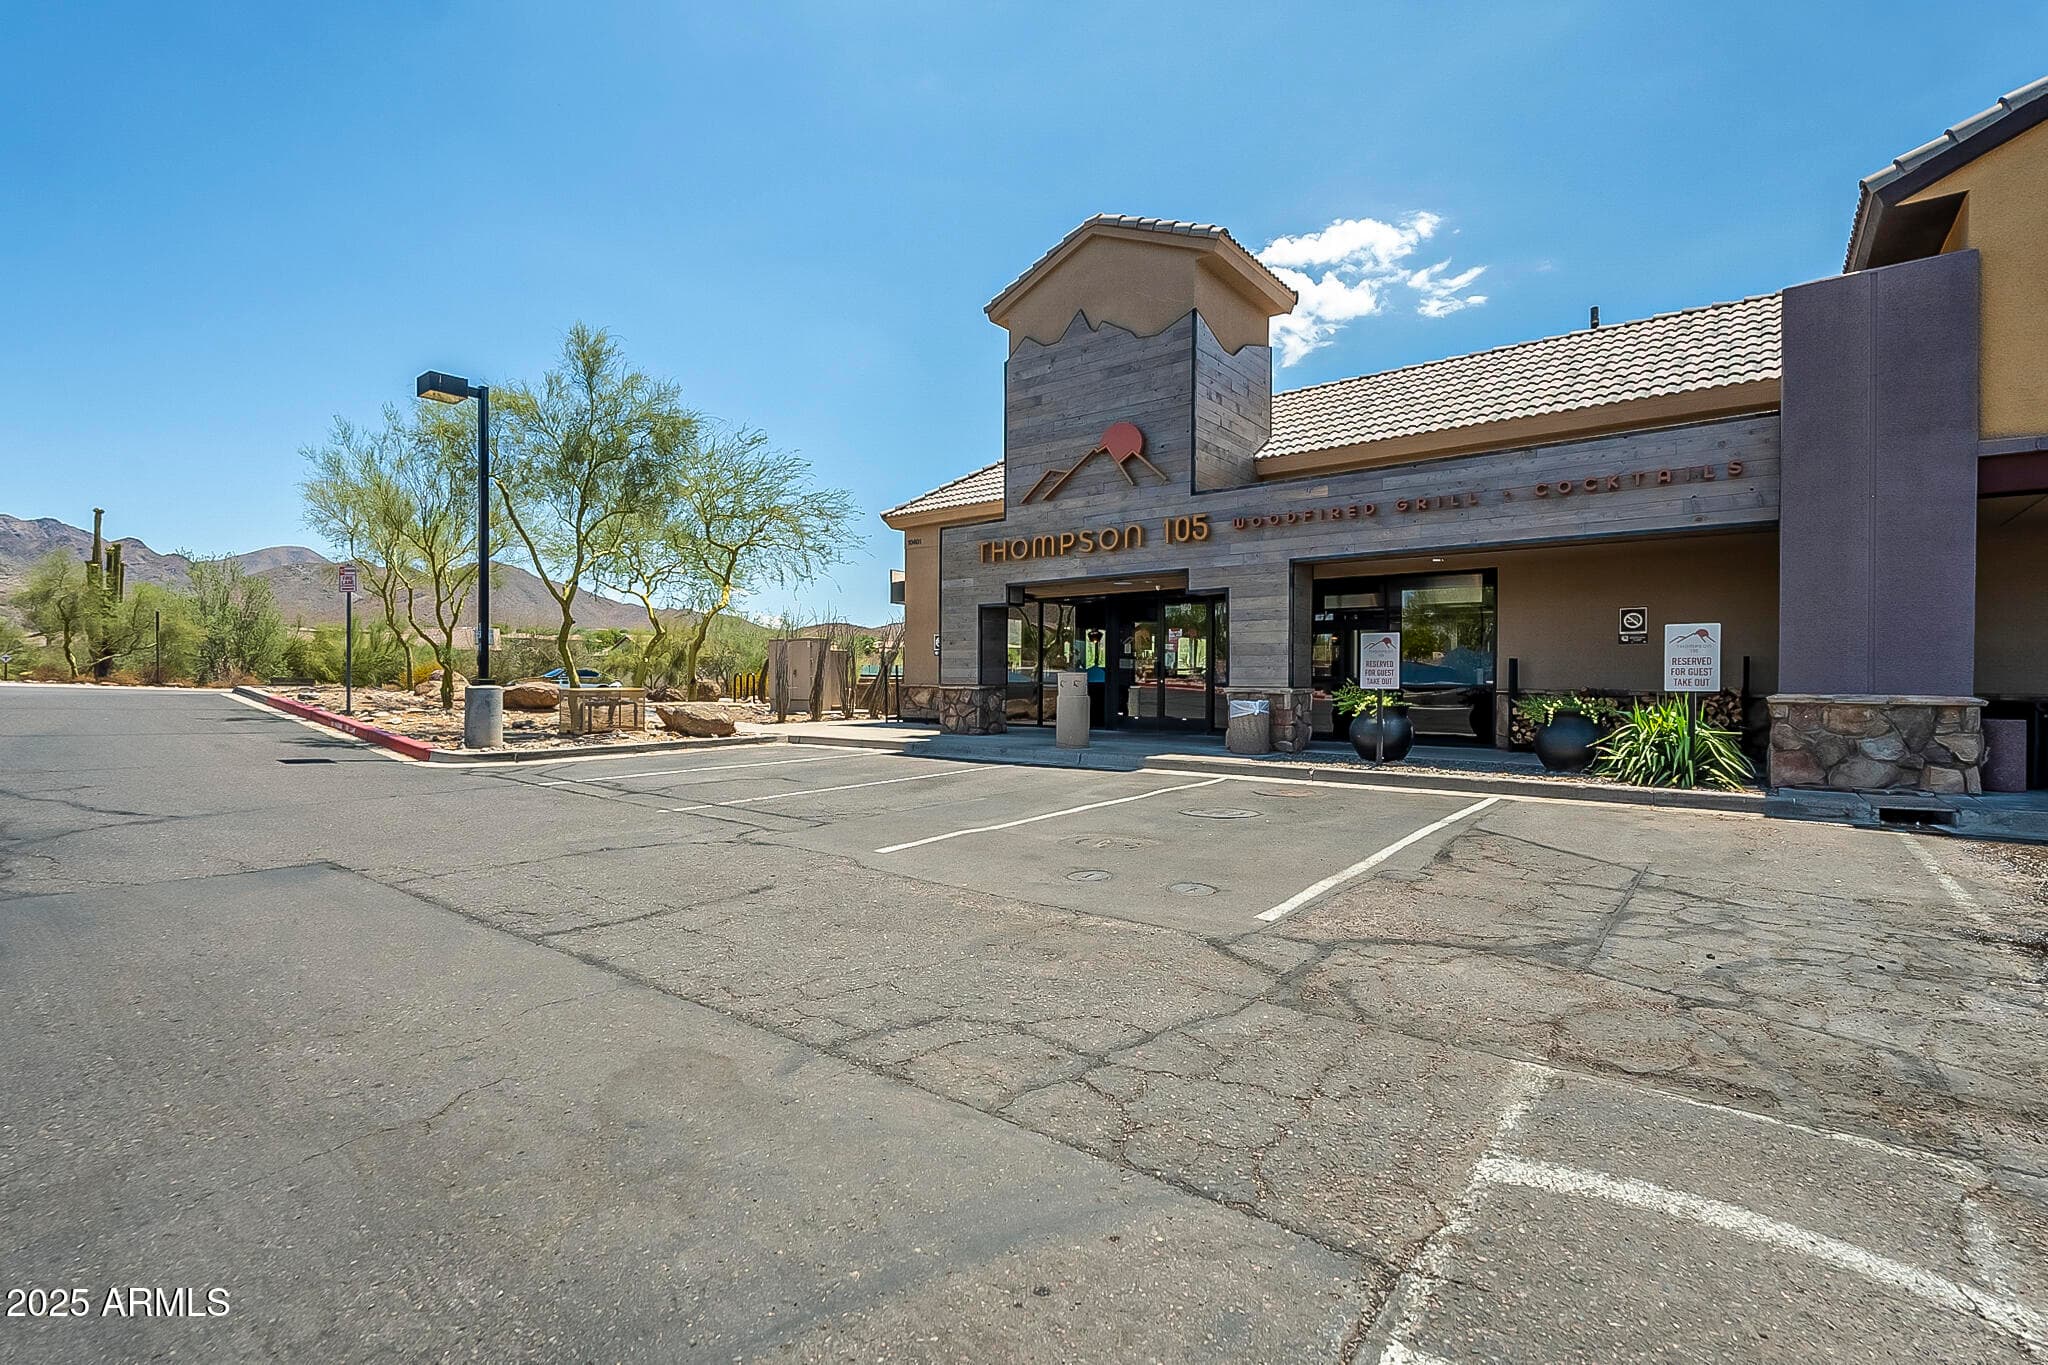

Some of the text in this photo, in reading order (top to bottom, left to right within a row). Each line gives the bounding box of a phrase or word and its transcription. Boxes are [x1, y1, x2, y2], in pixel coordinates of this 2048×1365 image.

[1232, 502, 1376, 529] WOODFIRED
[1395, 492, 1479, 512] GRILL
[1534, 458, 1744, 497] COCKTAILS
[977, 512, 1210, 563] THOMPSON 105
[1671, 657, 1712, 666] RESERVED
[1670, 667, 1713, 676] FOR GUEST
[1673, 678, 1710, 686] TAKE OUT
